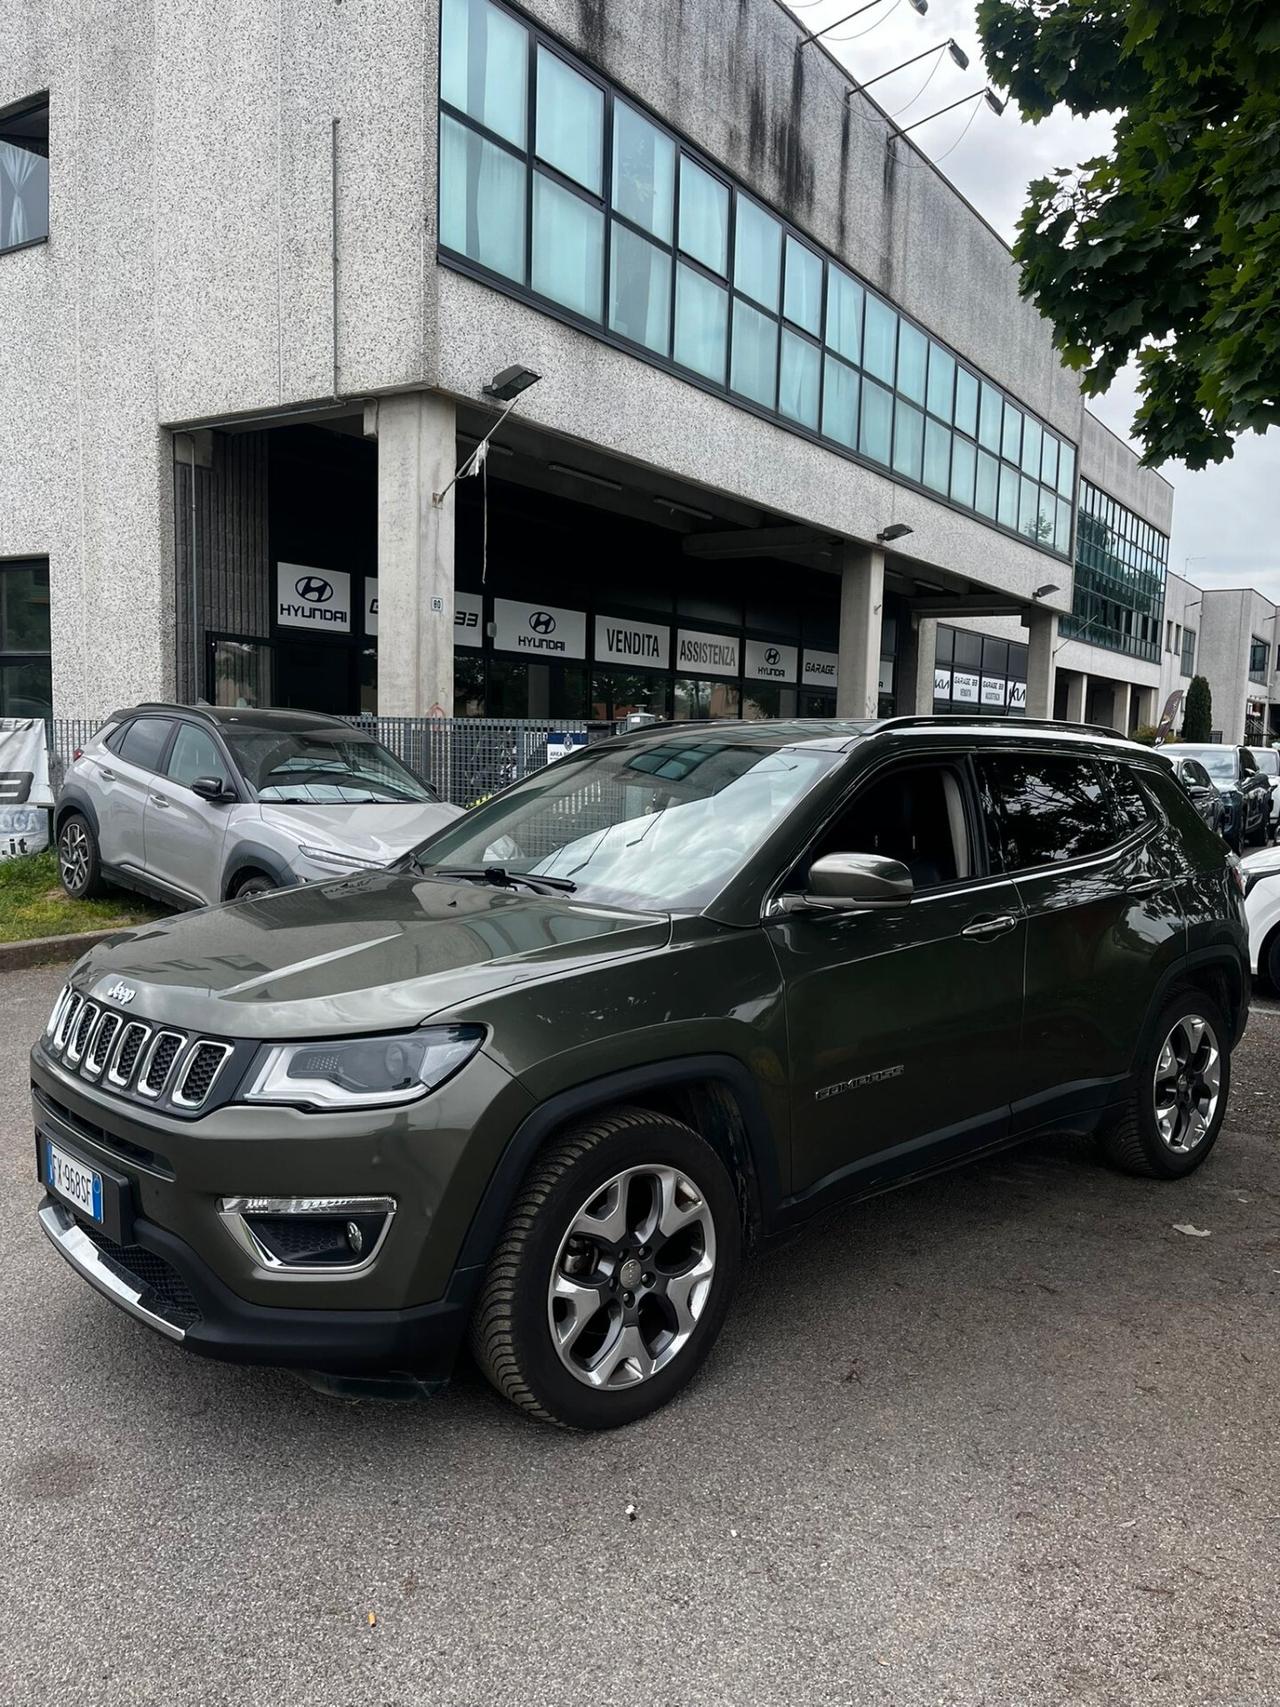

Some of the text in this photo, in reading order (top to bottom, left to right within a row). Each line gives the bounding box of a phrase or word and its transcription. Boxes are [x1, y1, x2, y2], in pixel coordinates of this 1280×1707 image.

[279, 603, 347, 623] HYUNDAI
[518, 635, 565, 652] HYUNDAI
[606, 628, 660, 657] VENDITA
[679, 640, 736, 667] ASSISTENZA
[757, 666, 785, 678] HYUNDAI
[805, 662, 836, 675] GARAGE
[107, 981, 137, 1006] Jeep
[815, 1064, 905, 1101] COMPASS
